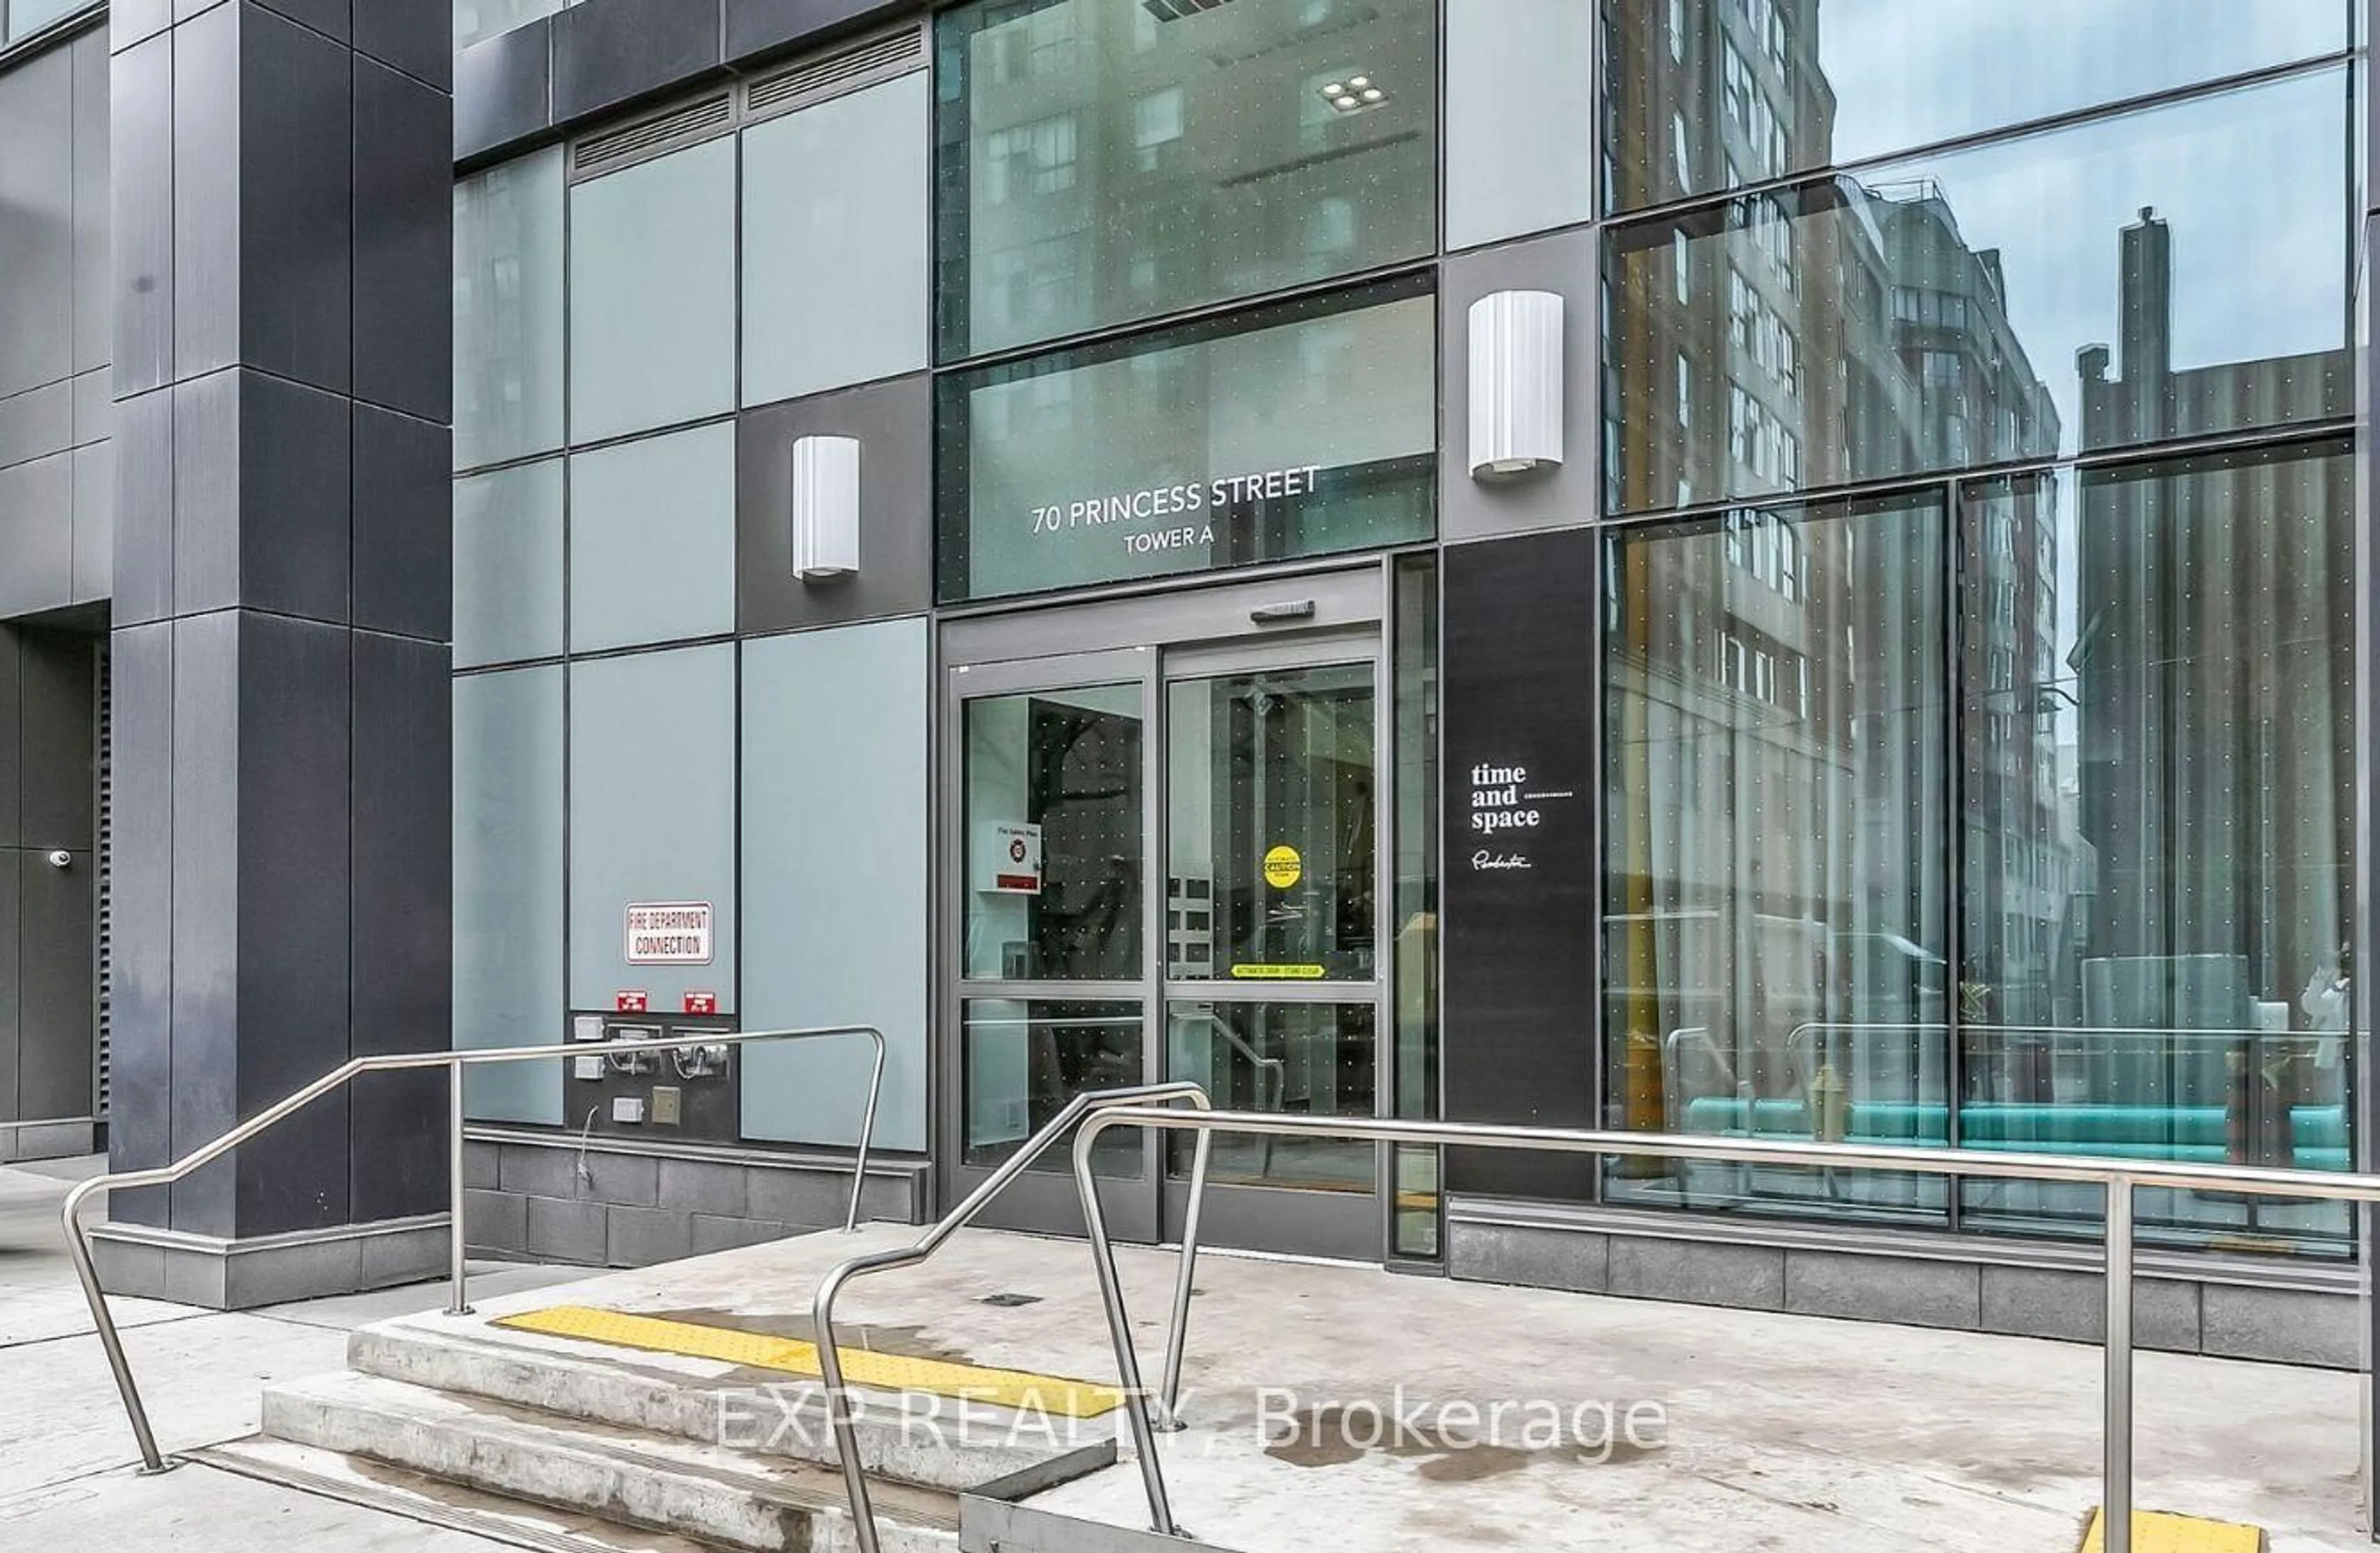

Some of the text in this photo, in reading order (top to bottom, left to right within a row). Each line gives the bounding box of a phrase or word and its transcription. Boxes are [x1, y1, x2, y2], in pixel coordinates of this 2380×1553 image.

[1031, 465, 1321, 534] 70 PRINCESS STREET
[1124, 526, 1214, 554] TOWER A
[1471, 763, 1526, 785] time
[1471, 784, 1518, 807] and
[1471, 809, 1540, 834] space
[628, 910, 707, 930] FIRE DEPARTMENT
[636, 936, 700, 954] CONNECTION
